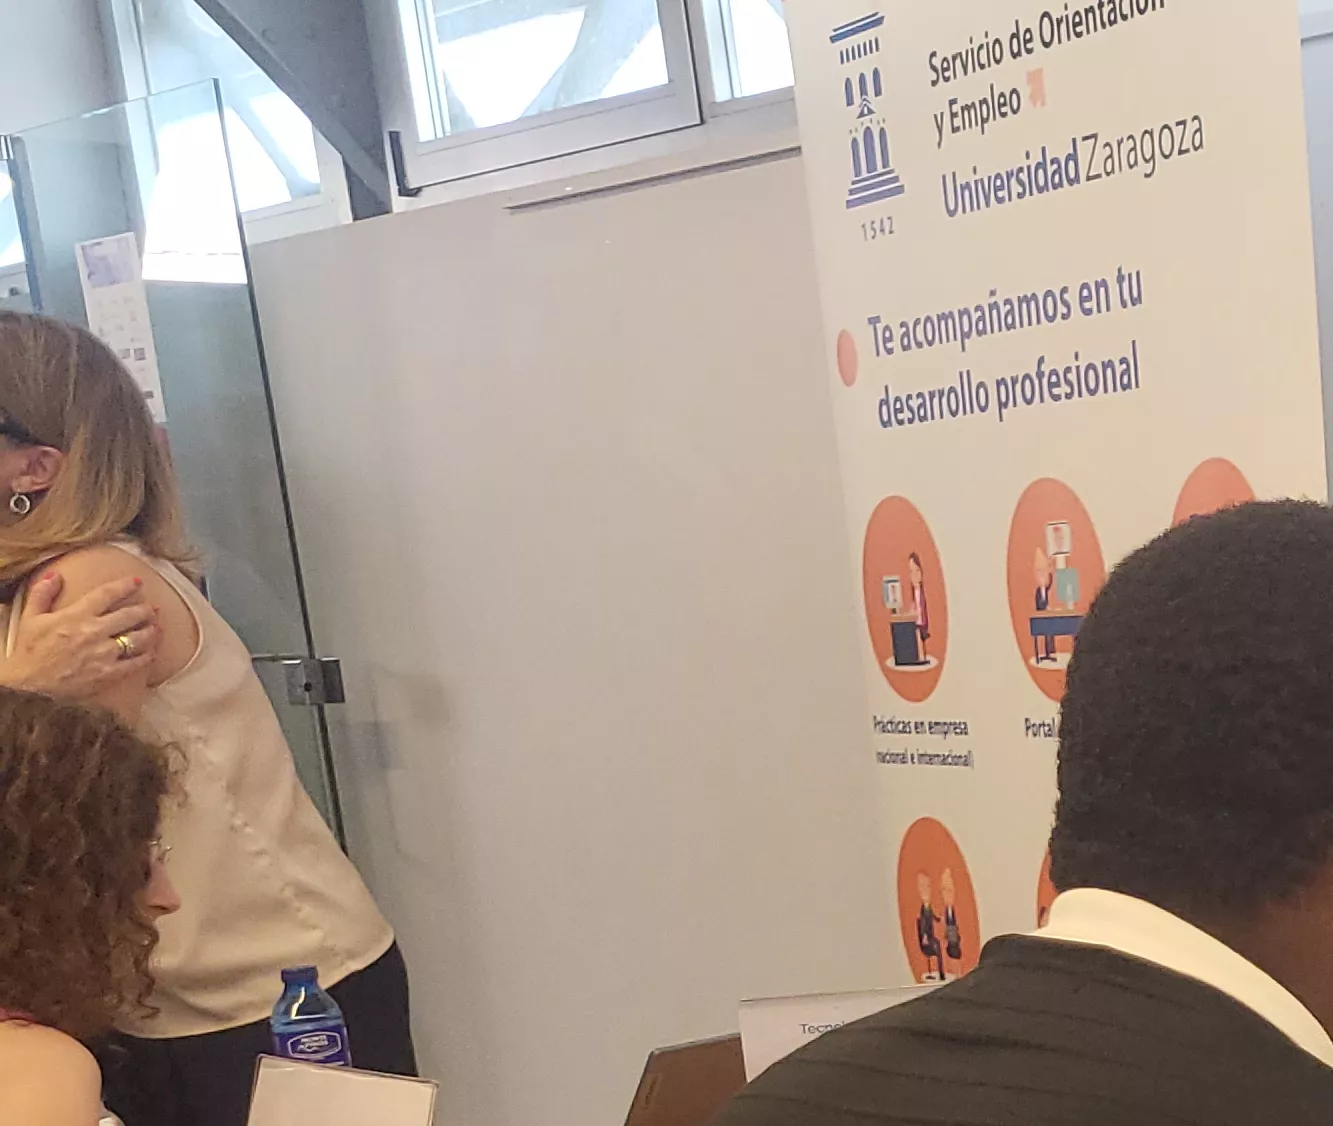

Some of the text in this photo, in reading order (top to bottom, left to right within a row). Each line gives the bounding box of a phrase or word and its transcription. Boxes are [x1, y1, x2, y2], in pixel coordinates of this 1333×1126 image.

[928, 30, 1004, 87] Servicio
[1009, 19, 1034, 60] de
[934, 83, 1021, 149] y Empleo
[861, 215, 895, 241] 1542
[868, 265, 1143, 357] Te acompañamos en tu
[879, 339, 1140, 428] desarrollo profesional
[1024, 717, 1057, 738] Portal
[800, 1020, 845, 1034] Tecn
